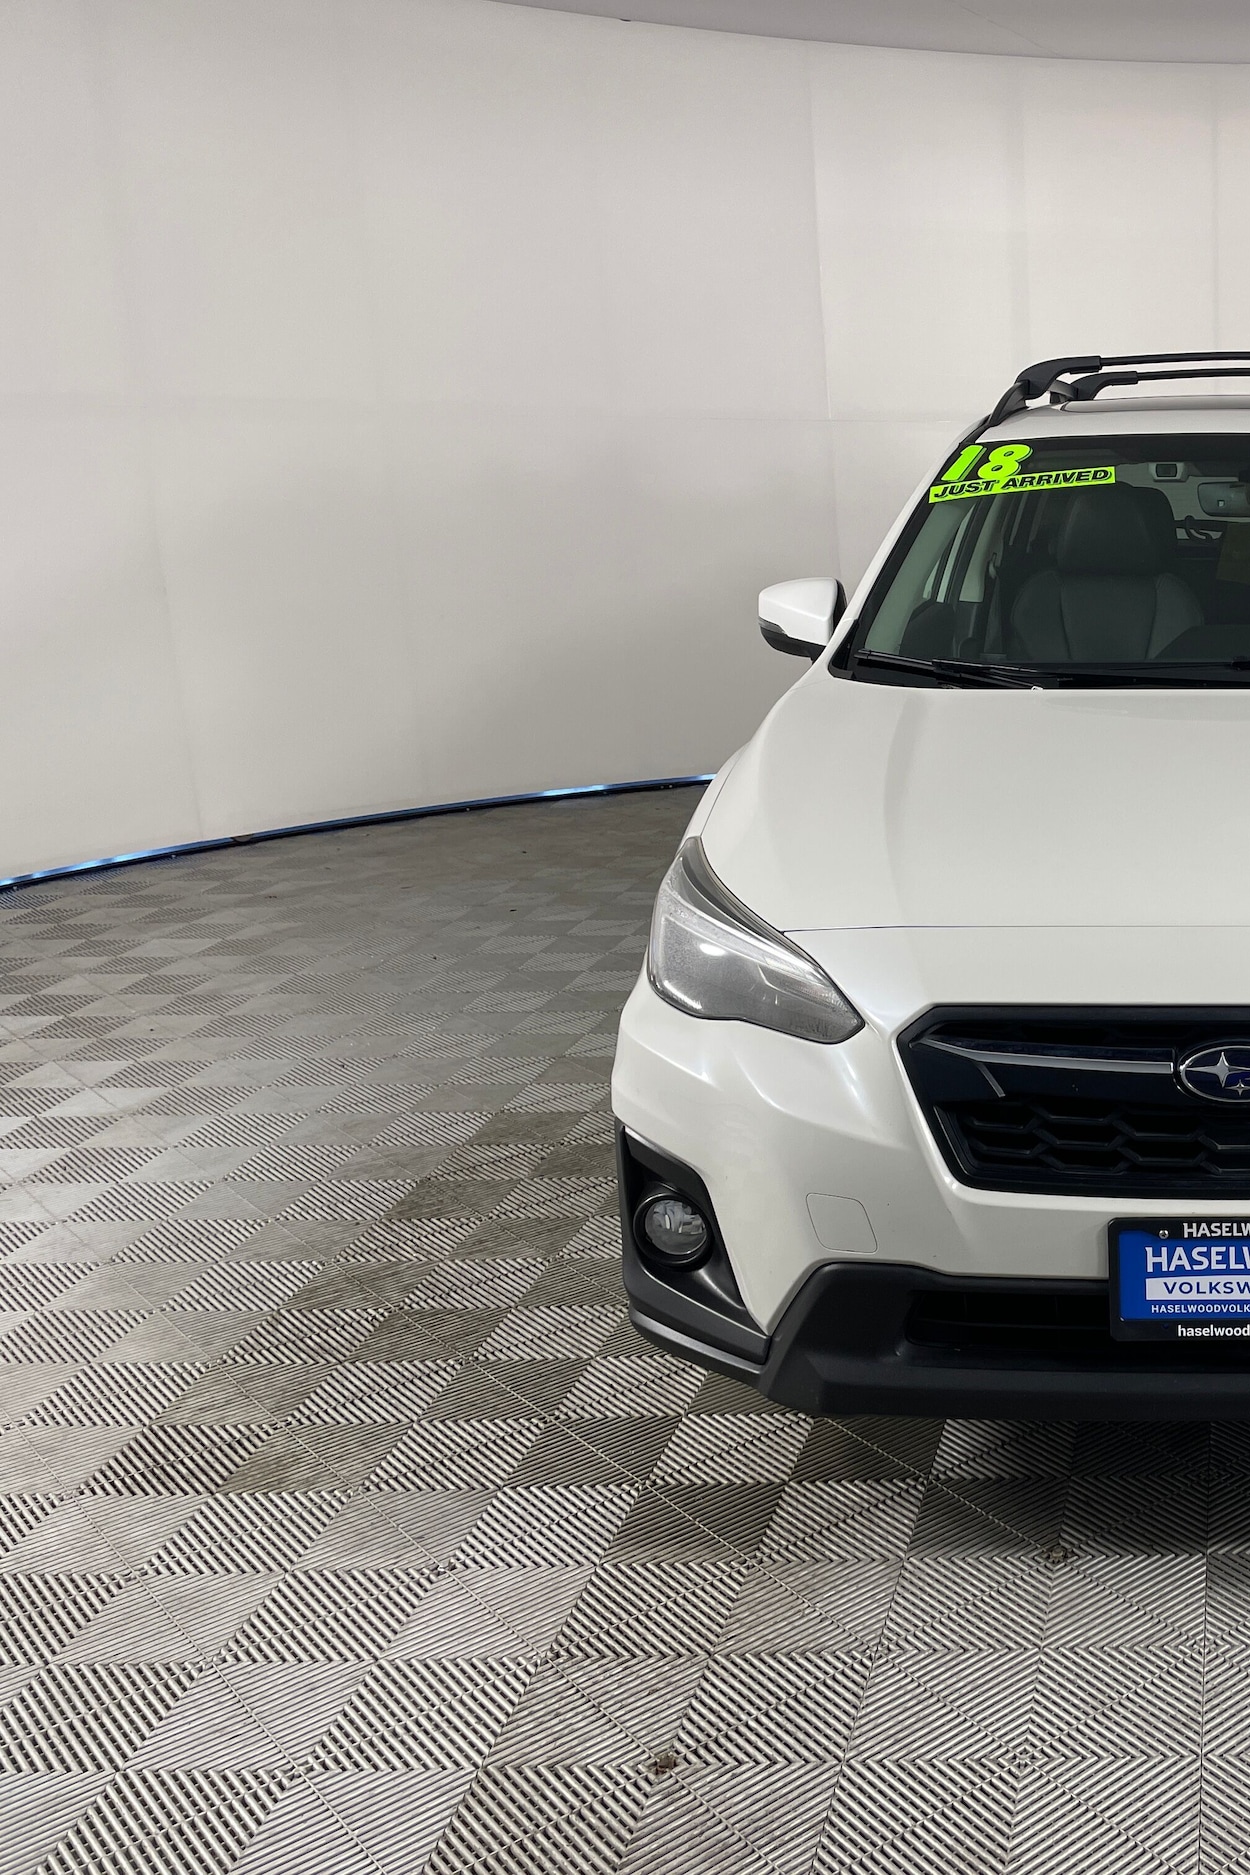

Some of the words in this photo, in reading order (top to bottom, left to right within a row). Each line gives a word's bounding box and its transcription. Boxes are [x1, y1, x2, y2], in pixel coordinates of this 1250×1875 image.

[941, 444, 1033, 481] 18
[934, 480, 997, 498] JUST
[1001, 469, 1112, 489] ARRIVED
